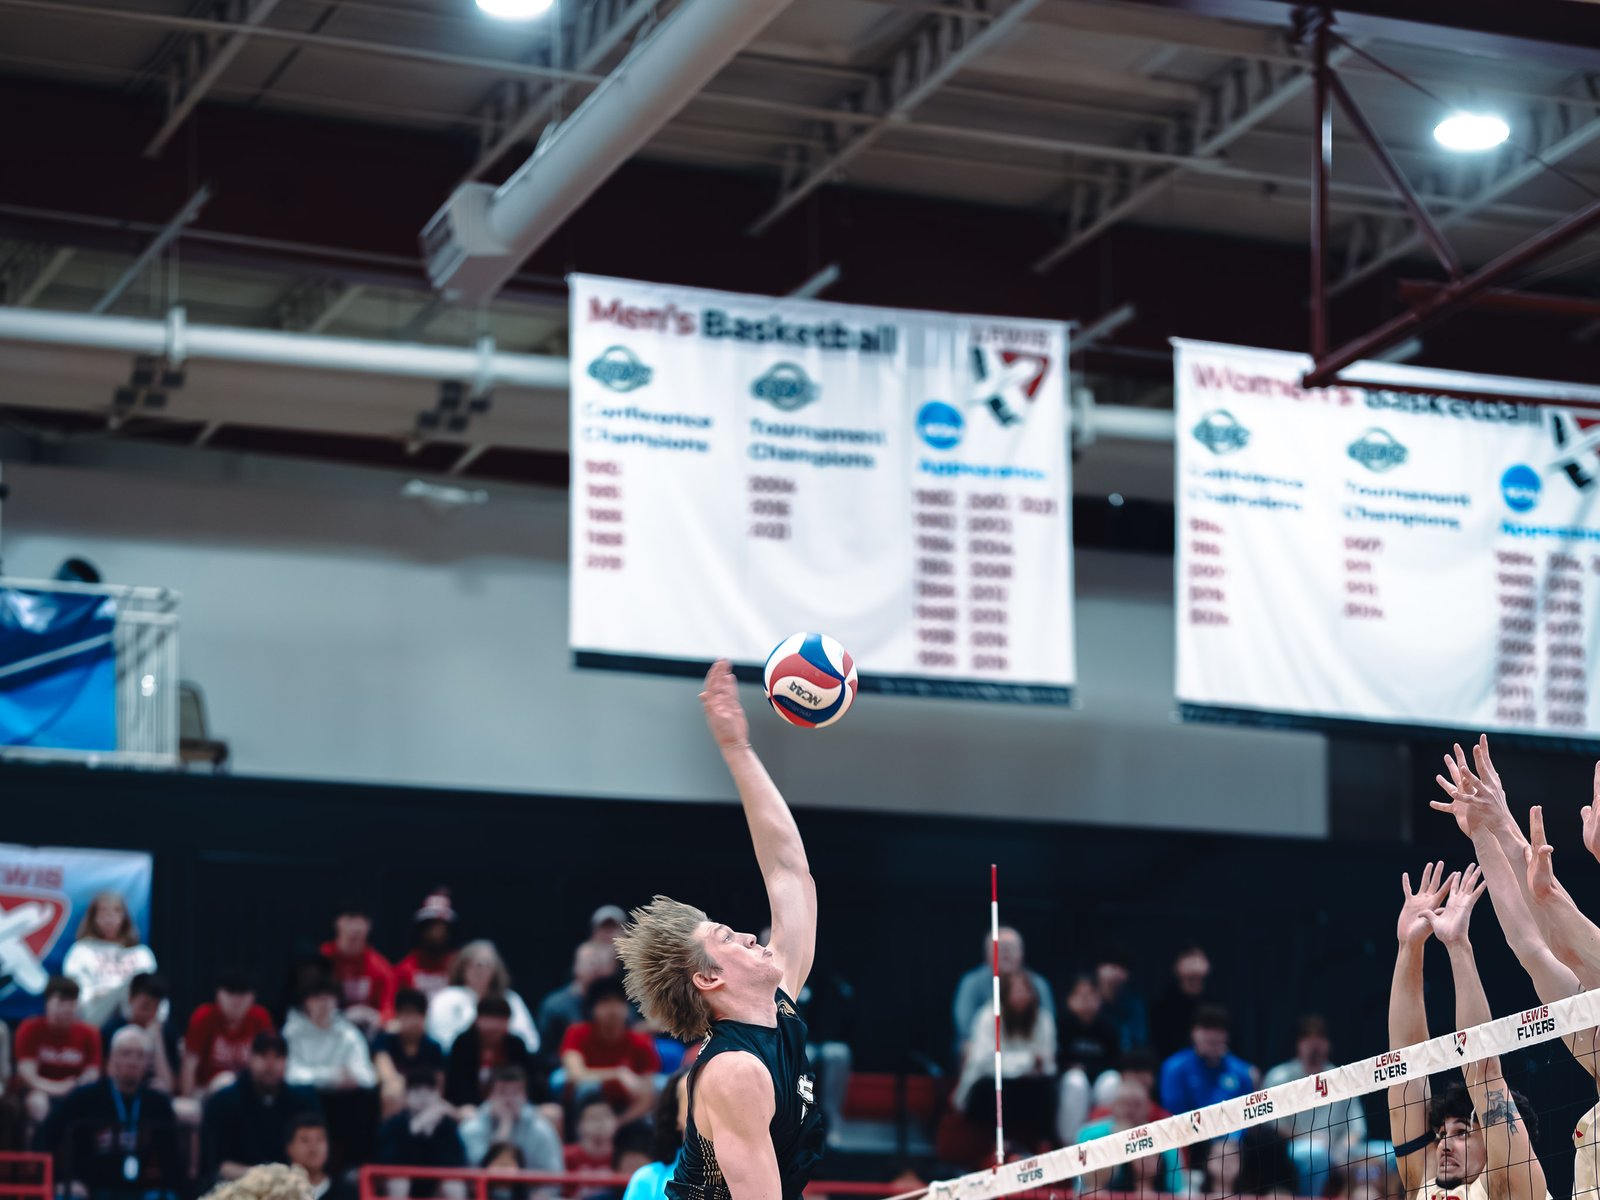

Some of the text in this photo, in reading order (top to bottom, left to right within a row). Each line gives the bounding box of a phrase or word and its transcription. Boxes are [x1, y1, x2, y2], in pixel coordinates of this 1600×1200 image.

[588, 297, 898, 355] Men's Basketball
[1192, 362, 1354, 406] Womens
[747, 442, 876, 468] Champions
[787, 680, 823, 706] NCAA
[1520, 1005, 1549, 1025] LEWIS
[1517, 1018, 1555, 1041] FLYERS
[1375, 1051, 1401, 1068] LEWIS
[1373, 1062, 1407, 1083] FLYERS
[1244, 1090, 1268, 1107] LEWIS
[1243, 1101, 1274, 1121] FLYERS
